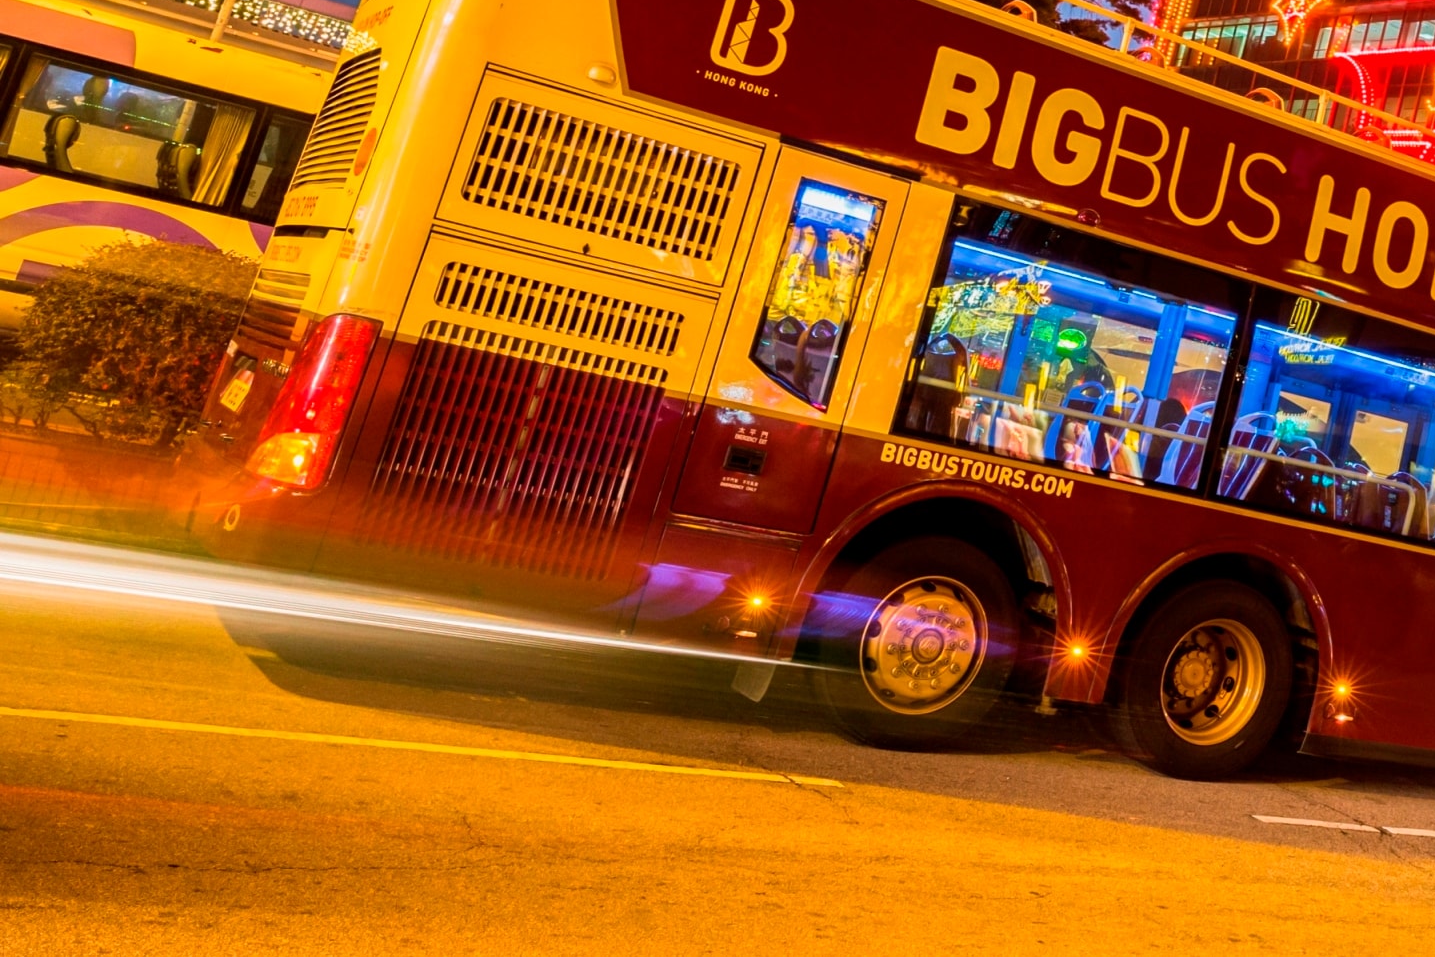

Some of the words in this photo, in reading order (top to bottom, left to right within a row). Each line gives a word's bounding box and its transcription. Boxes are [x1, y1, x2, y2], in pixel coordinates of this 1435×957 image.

[704, 69, 736, 87] HONG
[739, 80, 770, 97] KONG
[880, 442, 1075, 499] BIGBUSTOURS.COM
